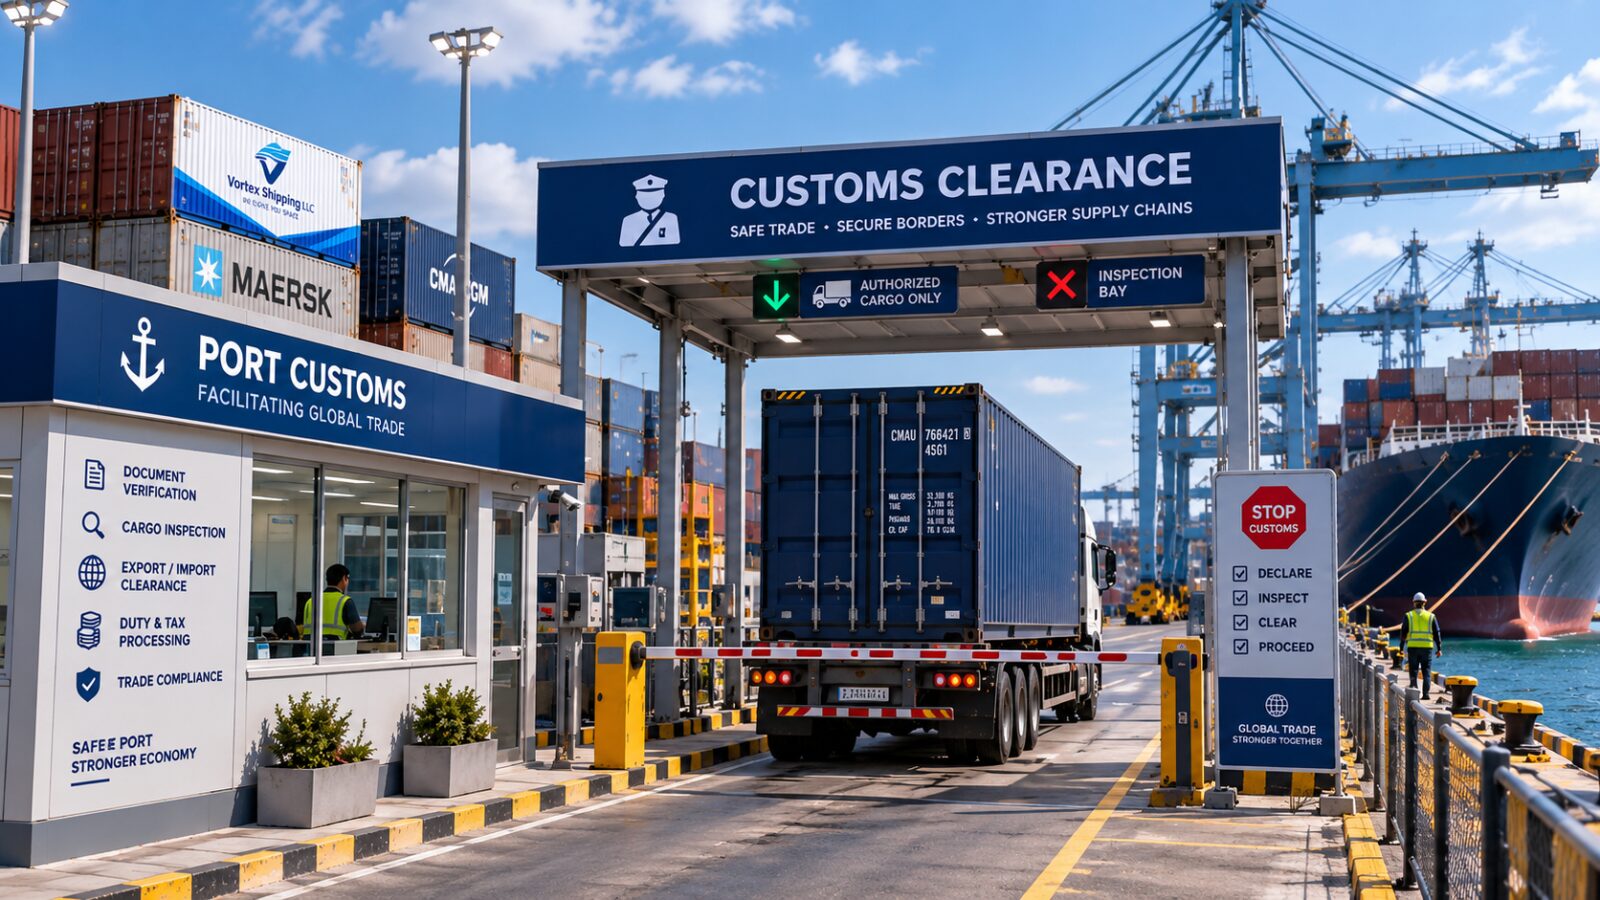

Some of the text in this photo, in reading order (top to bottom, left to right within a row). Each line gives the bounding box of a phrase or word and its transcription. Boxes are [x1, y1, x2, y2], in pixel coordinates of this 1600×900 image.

[730, 151, 1192, 210] CUSTOMS CLEARANCE
[228, 175, 260, 196] Vortex
[262, 187, 301, 212] Shipping
[302, 201, 315, 214] LLC
[730, 201, 1193, 238] SAFE TRADE SECURE BORDERS STRONGER SUPPLY CHAINS
[430, 267, 456, 296] CMA
[1098, 266, 1183, 282] INSPECTION
[232, 262, 333, 319] MAERSK
[859, 276, 941, 291] AUTHORIZED
[1099, 284, 1128, 298] BAY
[859, 292, 942, 307] CARGO ONLY
[199, 334, 407, 410] PORT CUSTOMS
[198, 384, 405, 437] FACILITATING GLOBAL TRADE
[890, 429, 917, 442] CMAU
[124, 465, 186, 483] DOCUMENT
[123, 483, 197, 501] VERIFICATION
[1252, 504, 1296, 520] STOP
[121, 520, 226, 539] CARGO INSPECTION
[1249, 523, 1299, 534] CUSTOMS
[121, 561, 167, 575] EXPORT
[176, 563, 216, 576] IMPORT
[1258, 567, 1313, 579] DECLARE
[120, 578, 187, 592] CLEARANCE
[1258, 592, 1309, 604] INSPECT
[119, 616, 186, 630] DUTY & TAX
[1258, 616, 1297, 628] CLEAR
[119, 633, 191, 648] PROCESSING
[1259, 641, 1315, 653] PROCEED
[117, 670, 223, 689] TRADE COMPLIANCE
[1238, 723, 1317, 735] GLOBAL TRADE
[119, 733, 154, 750] PORT
[1232, 735, 1323, 746] STRONGER TOGETHER
[71, 747, 197, 774] STRONGER ECONOMY
